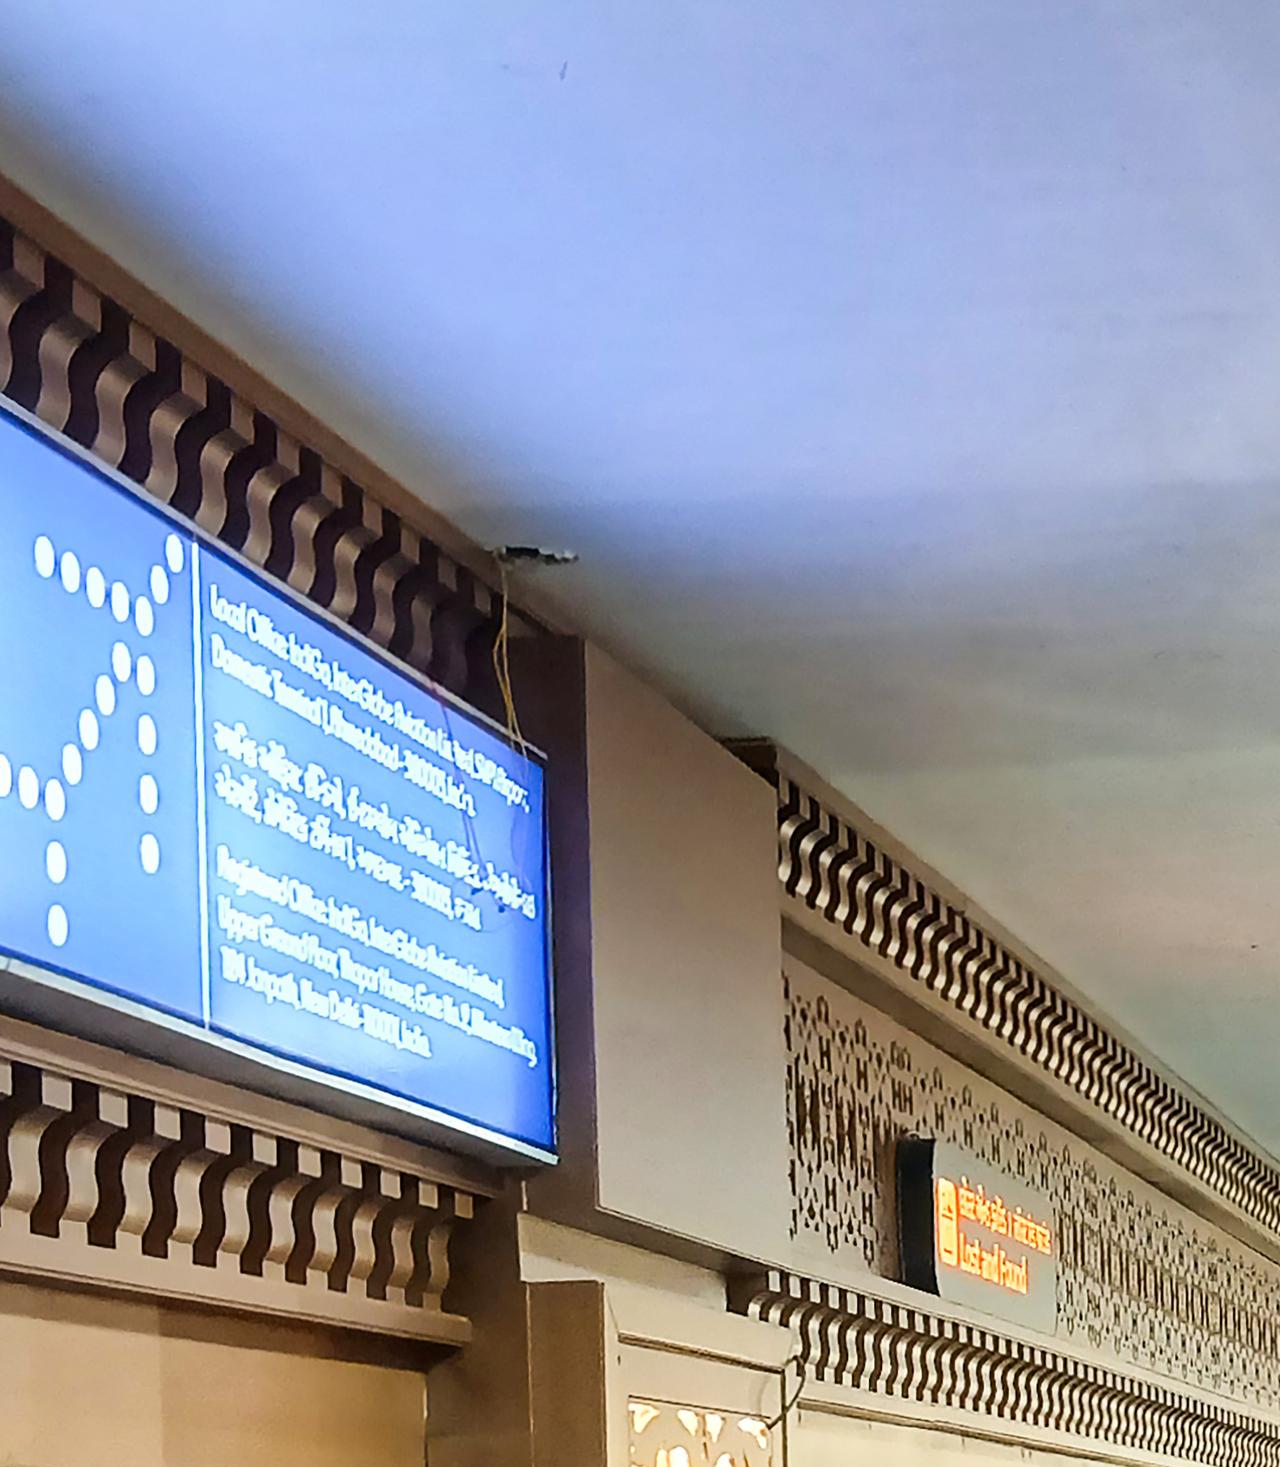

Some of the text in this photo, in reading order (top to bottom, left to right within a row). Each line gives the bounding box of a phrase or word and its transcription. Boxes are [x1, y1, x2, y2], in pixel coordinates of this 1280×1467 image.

[210, 584, 245, 633] Local
[217, 844, 289, 905] Registered
[217, 894, 259, 942] Upper
[258, 914, 306, 961] Ground
[960, 1231, 1028, 1295] Lost and Found
